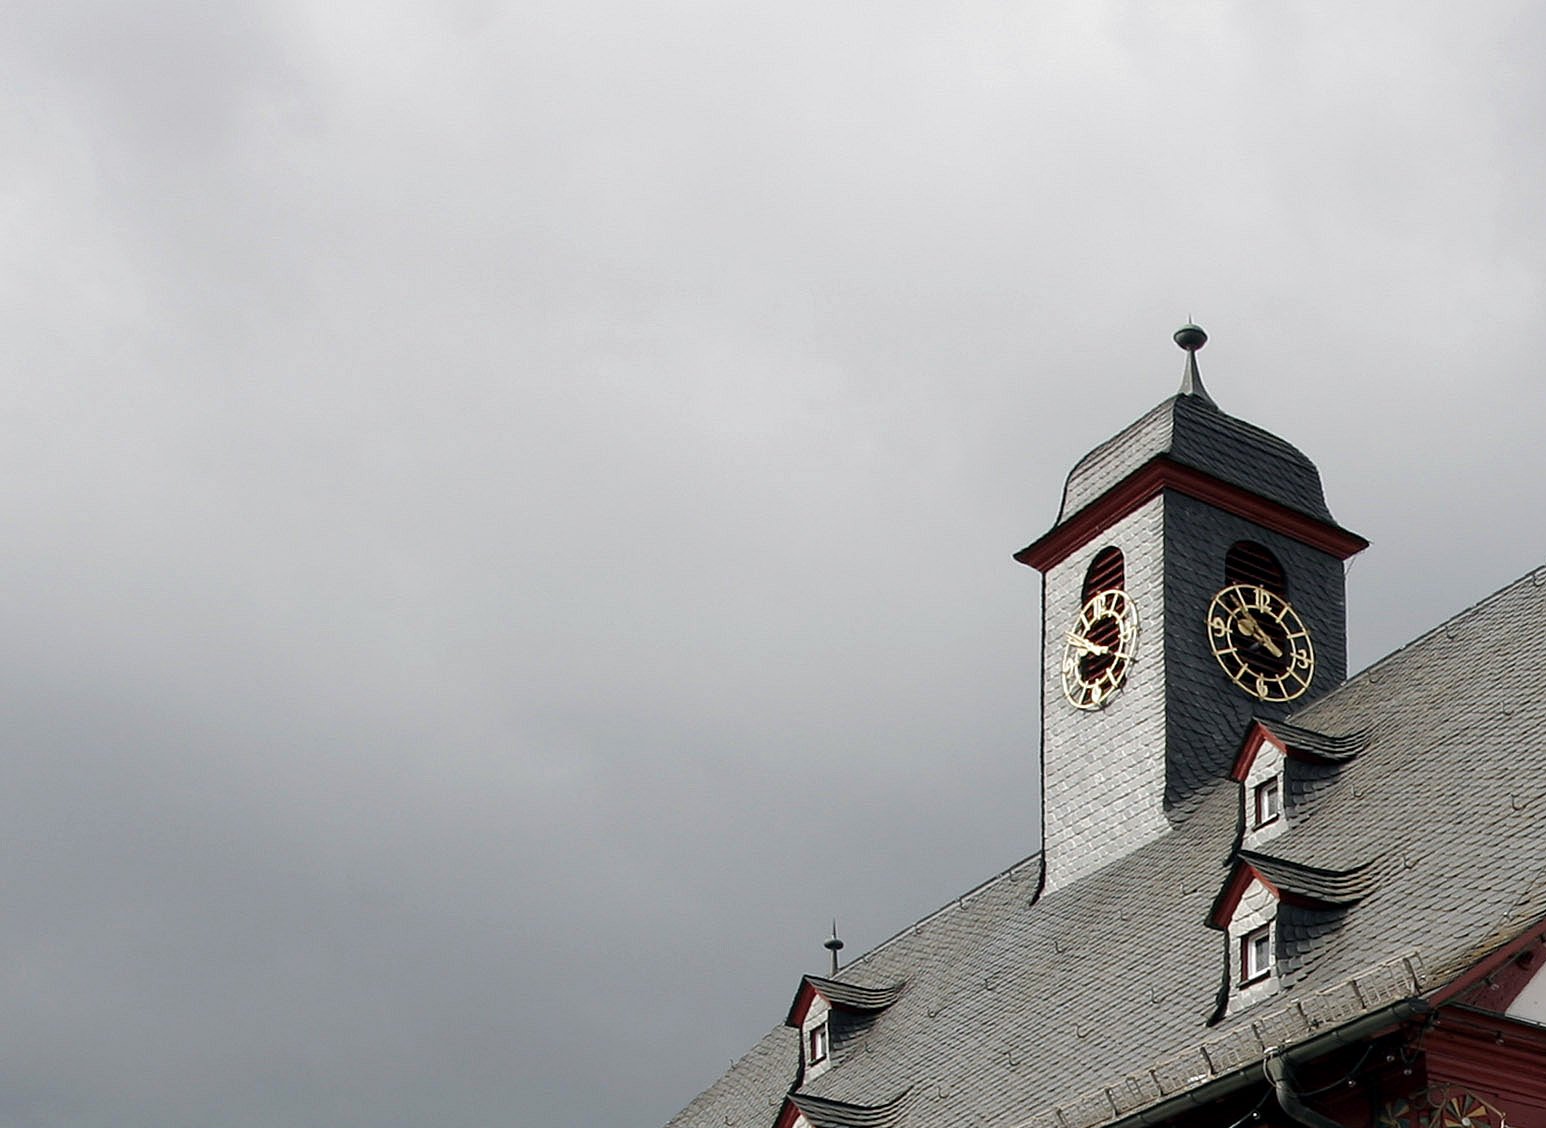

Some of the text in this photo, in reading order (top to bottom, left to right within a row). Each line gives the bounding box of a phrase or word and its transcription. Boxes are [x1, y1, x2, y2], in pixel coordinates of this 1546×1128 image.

[1253, 587, 1273, 613] 12
[1213, 616, 1226, 638] 9
[1297, 648, 1309, 670] 3
[1255, 677, 1269, 699] 6
